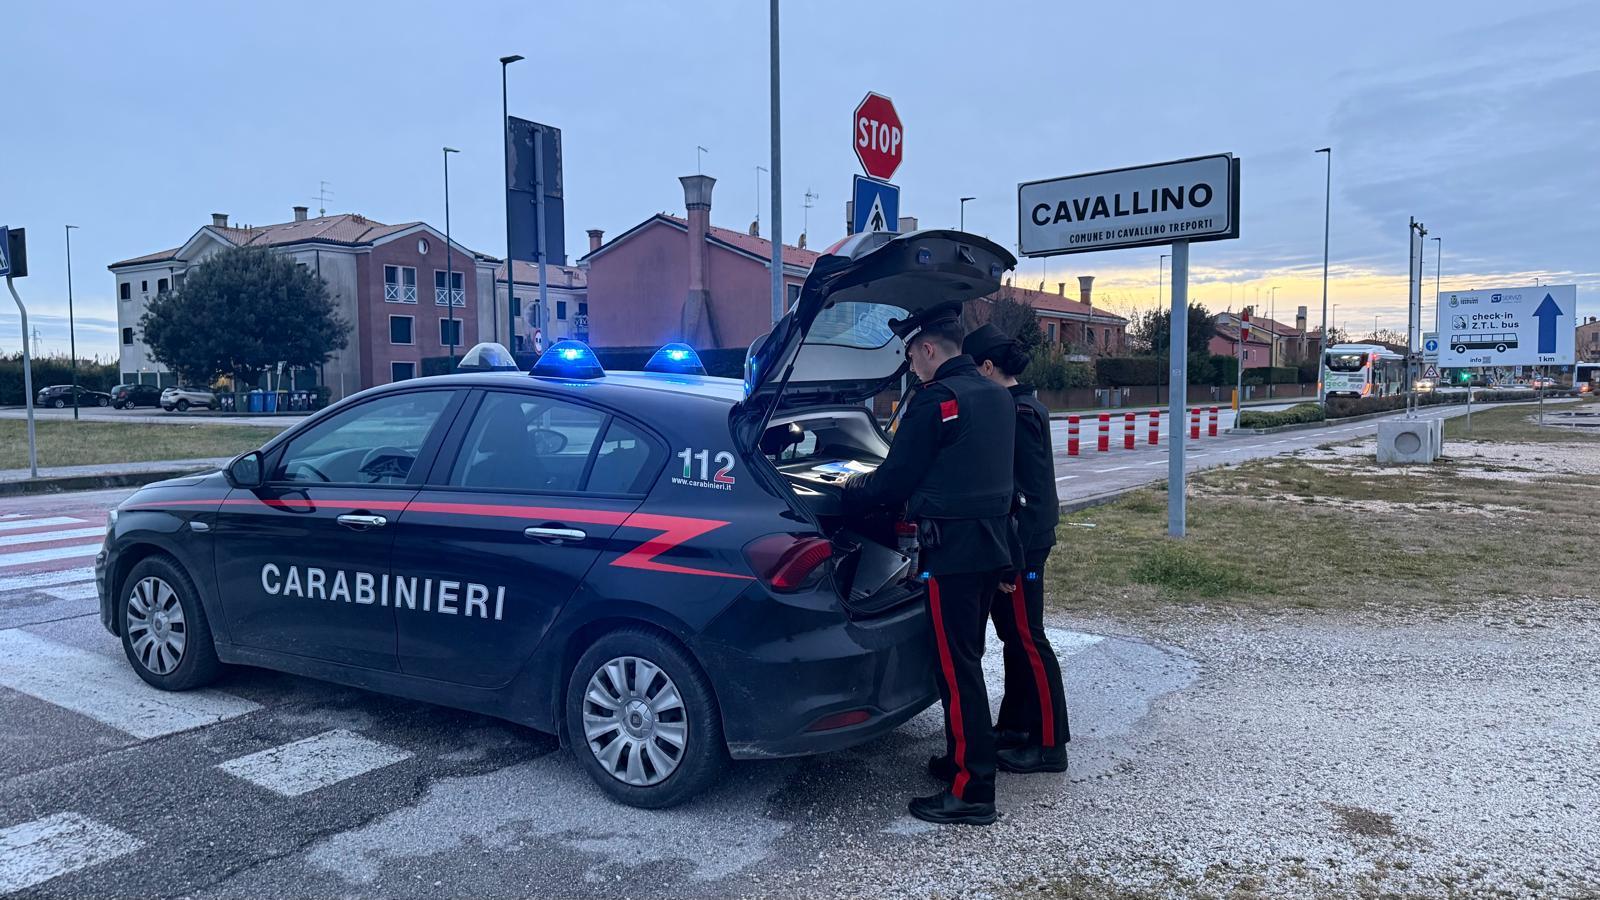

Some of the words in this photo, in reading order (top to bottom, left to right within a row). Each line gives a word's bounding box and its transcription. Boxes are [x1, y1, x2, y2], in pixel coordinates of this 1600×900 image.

[859, 117, 901, 156] STOP
[1031, 183, 1213, 226] CAVALLINO
[1069, 231, 1104, 244] COMUNE
[1106, 229, 1115, 240] DI
[1117, 224, 1166, 238] CAVALLINO
[1169, 218, 1213, 233] TREPORTI
[1472, 312, 1513, 321] check-in
[671, 477, 732, 491] www.carabinieri.it
[677, 447, 735, 485] 112
[261, 563, 506, 620] CARABINIERI
